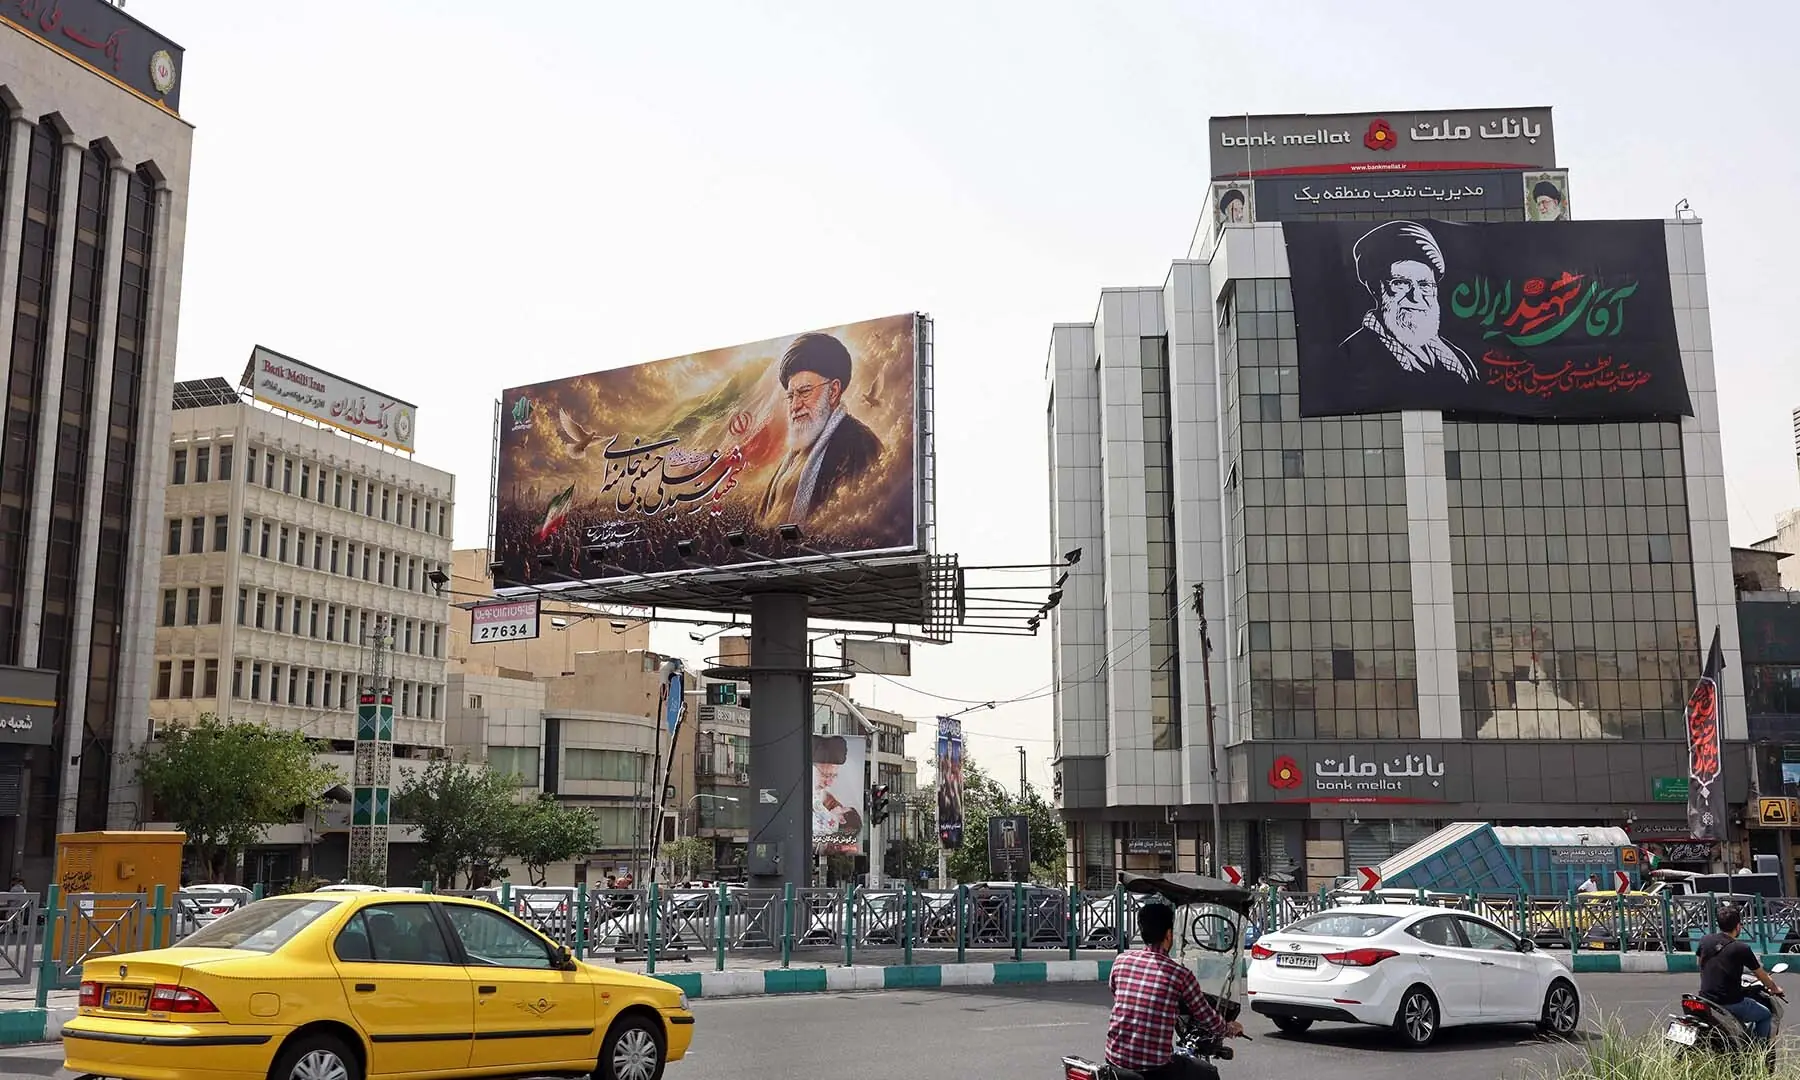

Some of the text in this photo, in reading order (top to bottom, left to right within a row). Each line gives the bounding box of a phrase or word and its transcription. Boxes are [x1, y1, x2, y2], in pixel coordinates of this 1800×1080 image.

[1221, 129, 1351, 147] bank mellat
[1410, 119, 1471, 141] ملت
[1350, 163, 1407, 171] www.bankmellat.ir
[1294, 185, 1484, 204] مدیریت شعب منطقه یک
[1452, 276, 1512, 341] ایران
[1504, 271, 1586, 335] شهید
[262, 359, 326, 393] Bank Melli Iran
[481, 624, 527, 639] 27634
[8, 714, 33, 733] شعبه
[1315, 754, 1377, 777] ملت
[1316, 779, 1402, 790] bank mellat
